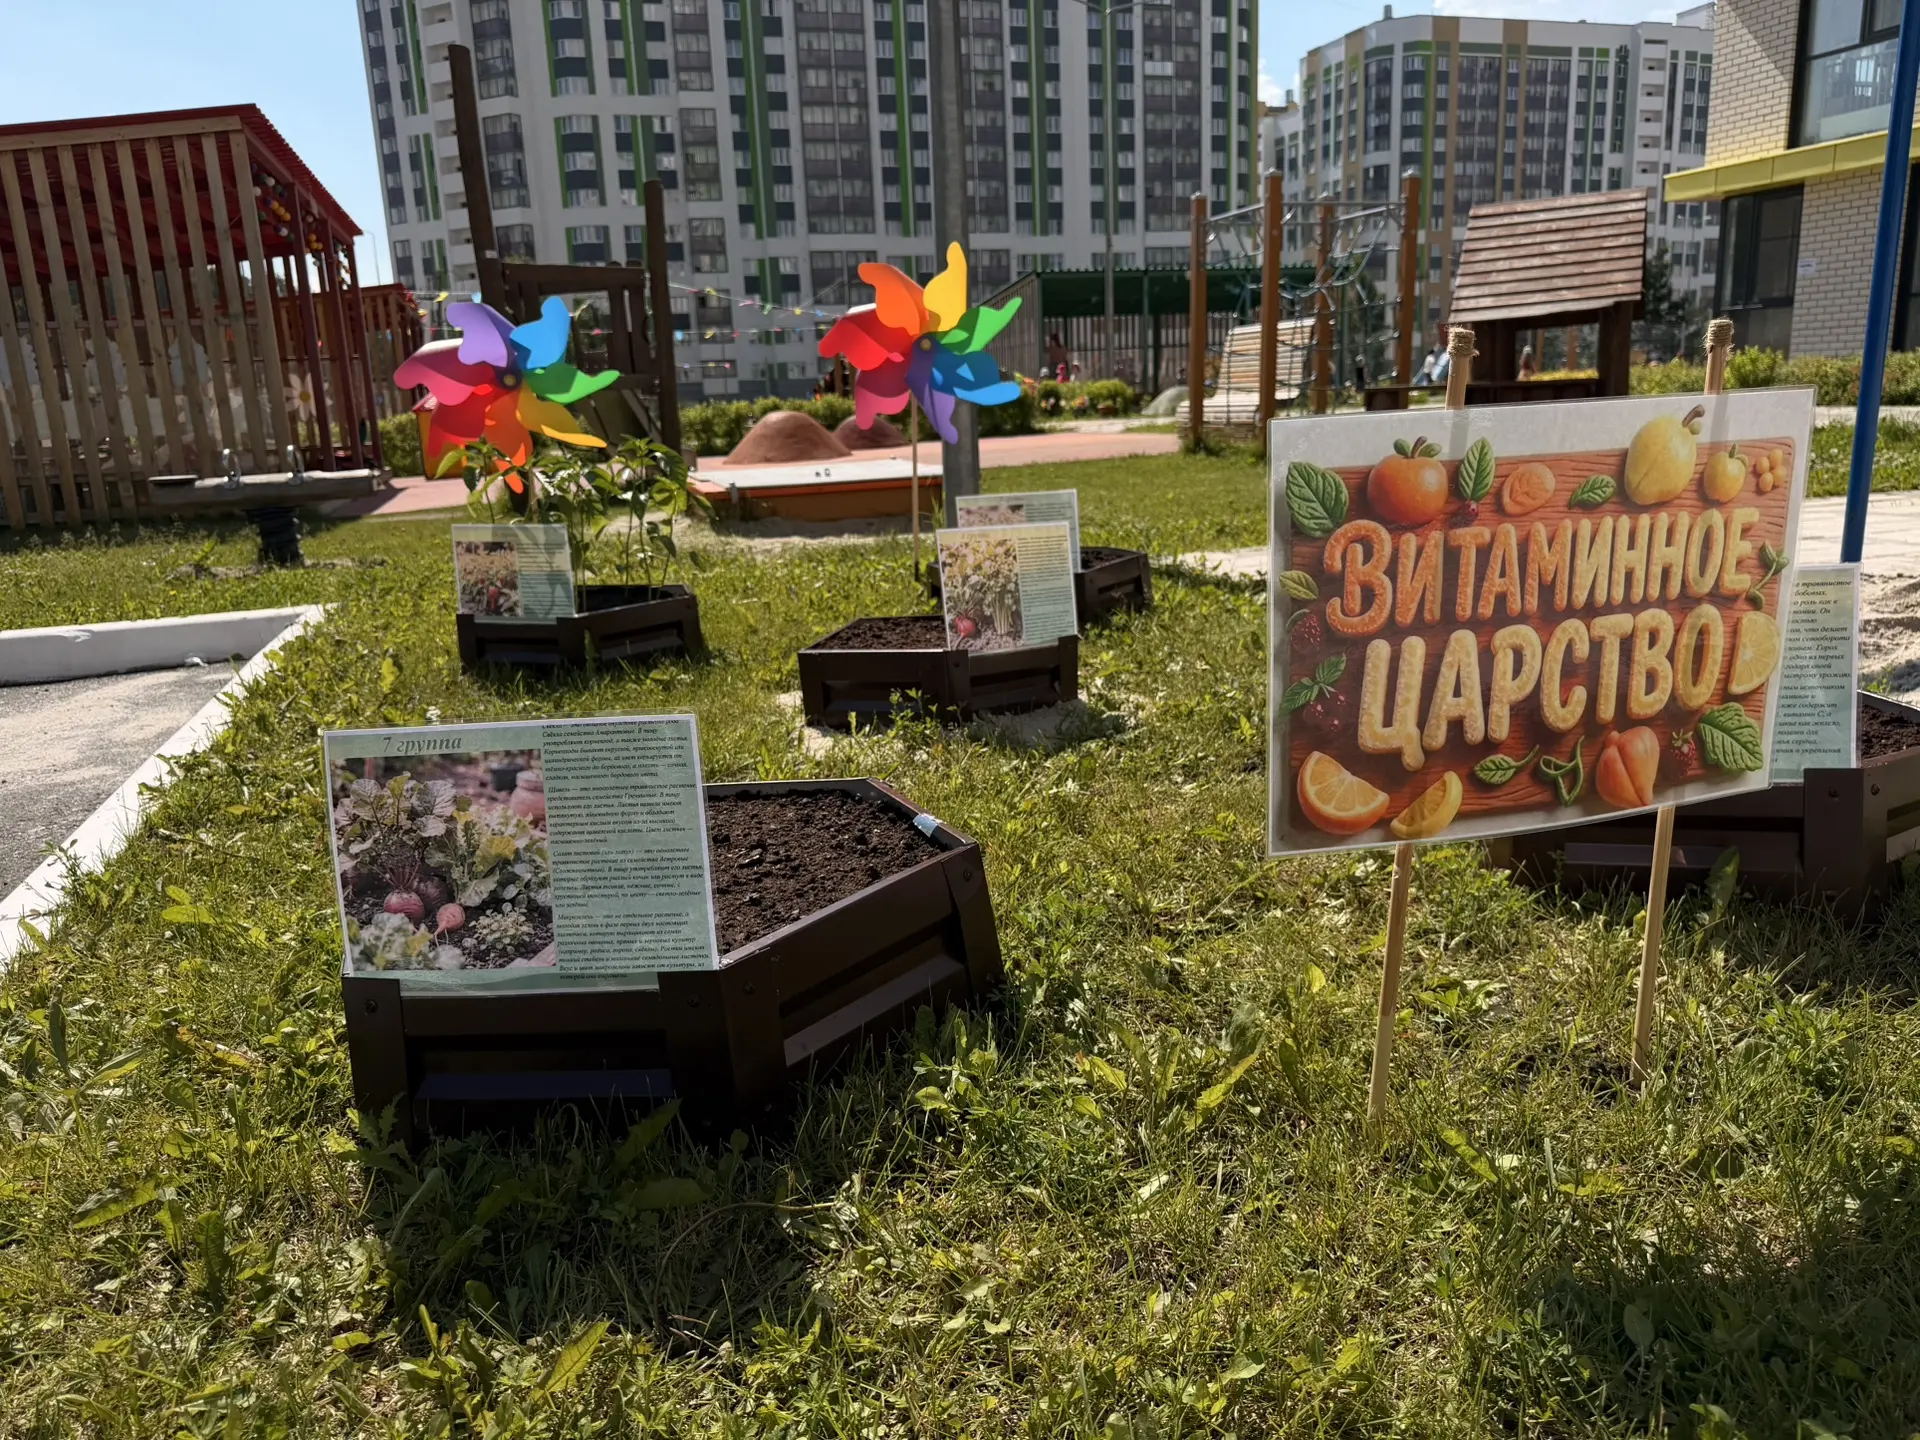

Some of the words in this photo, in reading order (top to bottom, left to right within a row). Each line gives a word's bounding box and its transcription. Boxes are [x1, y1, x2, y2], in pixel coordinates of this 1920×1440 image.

[1322, 506, 1760, 638] ВИТАМИННОЕ
[383, 737, 392, 752] 7
[396, 736, 462, 756] группа
[1356, 603, 1724, 771] ЦАРСТВО
